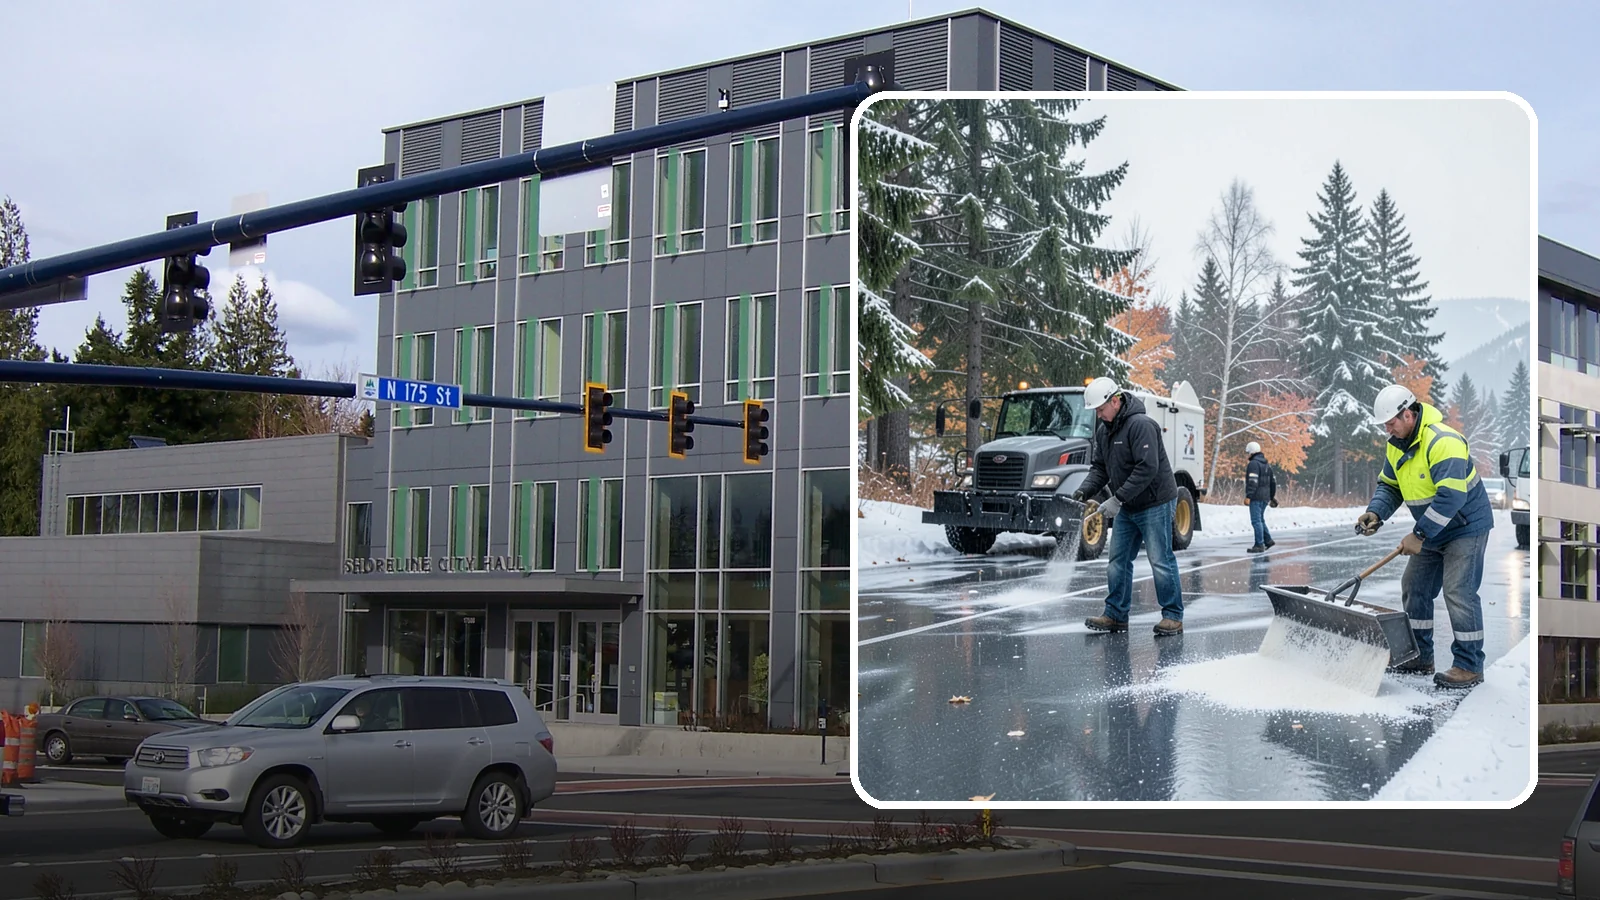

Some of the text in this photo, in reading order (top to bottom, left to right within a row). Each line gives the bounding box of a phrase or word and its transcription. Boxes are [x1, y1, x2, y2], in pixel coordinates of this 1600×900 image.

[387, 380, 451, 406] N 175 St
[344, 555, 525, 574] SHORELINE CITY HALL
